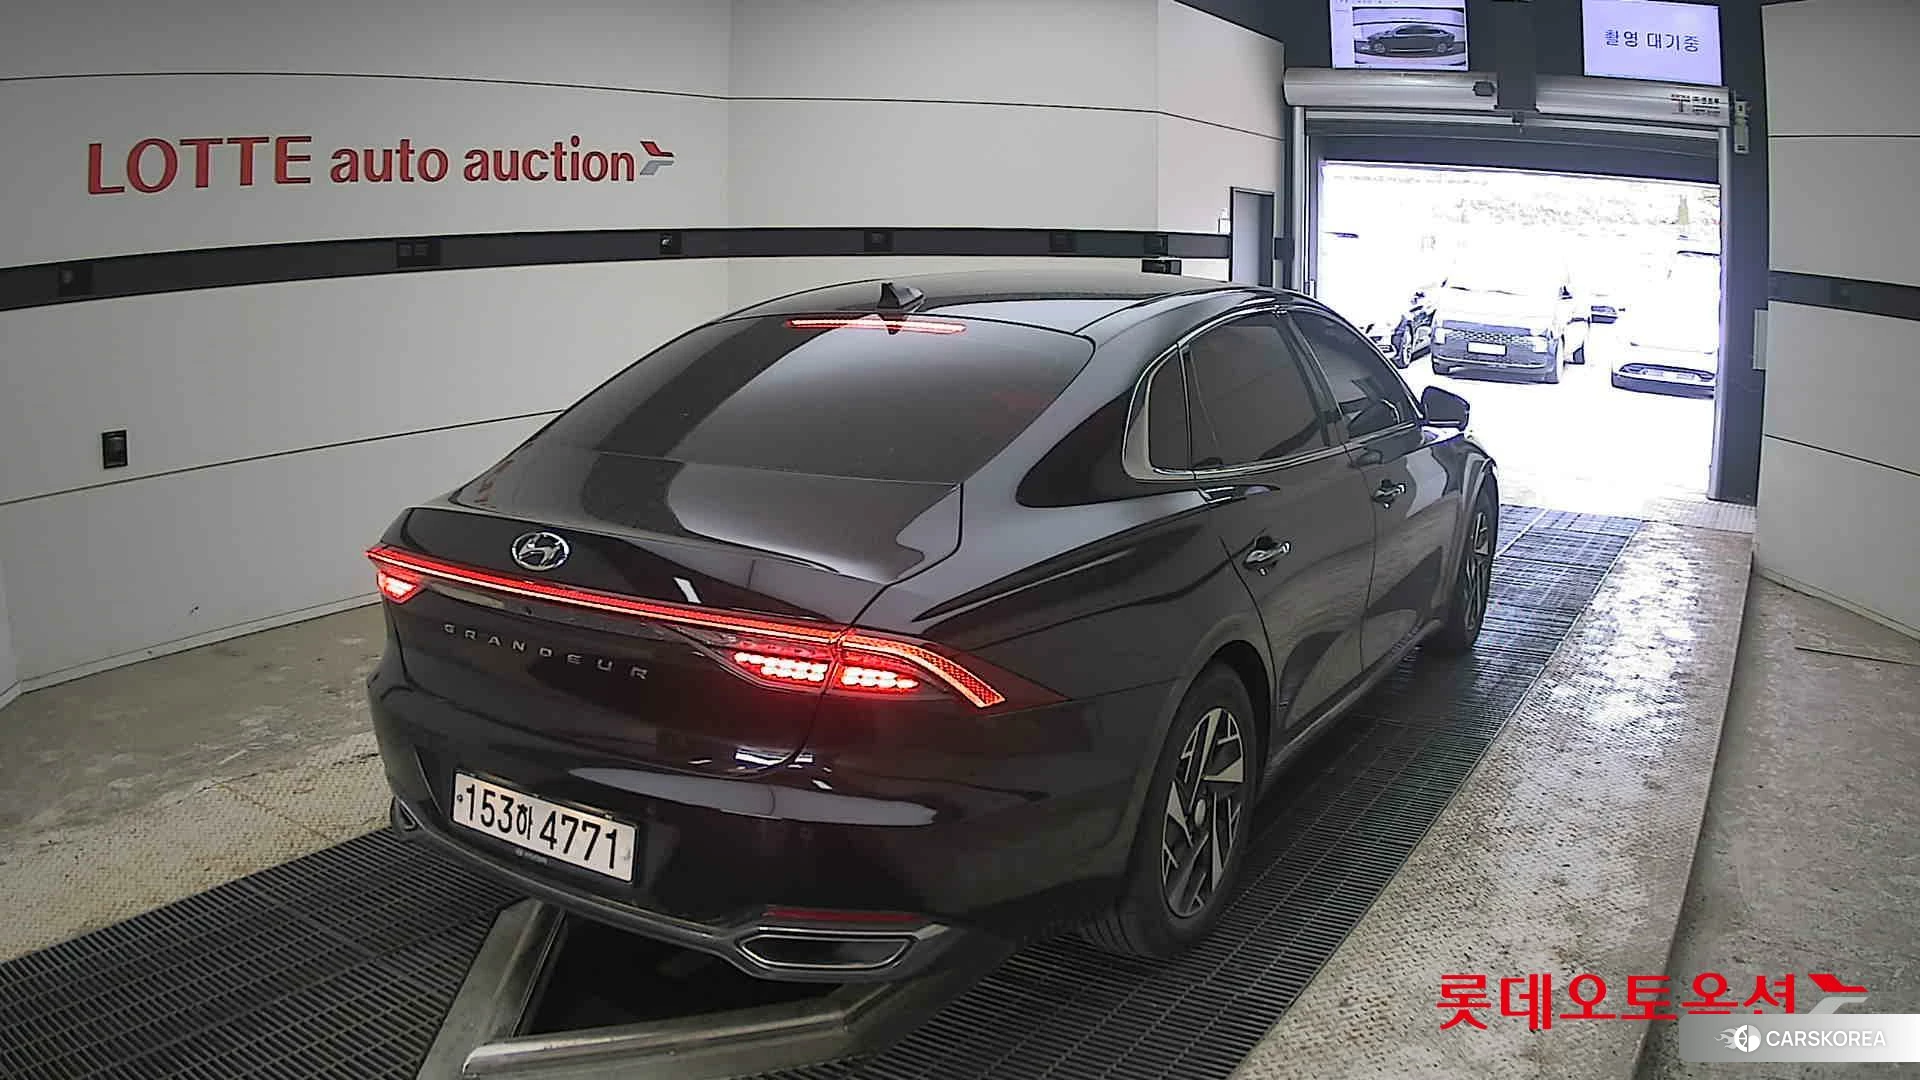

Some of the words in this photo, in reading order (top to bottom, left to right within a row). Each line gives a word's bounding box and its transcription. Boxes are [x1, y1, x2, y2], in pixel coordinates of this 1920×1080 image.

[1647, 32, 1700, 53] 대기중
[87, 136, 312, 195] LOTTE
[329, 139, 448, 184] auto
[463, 136, 634, 182] auction
[443, 623, 649, 681] GRANDEUR
[539, 811, 618, 870] 4771
